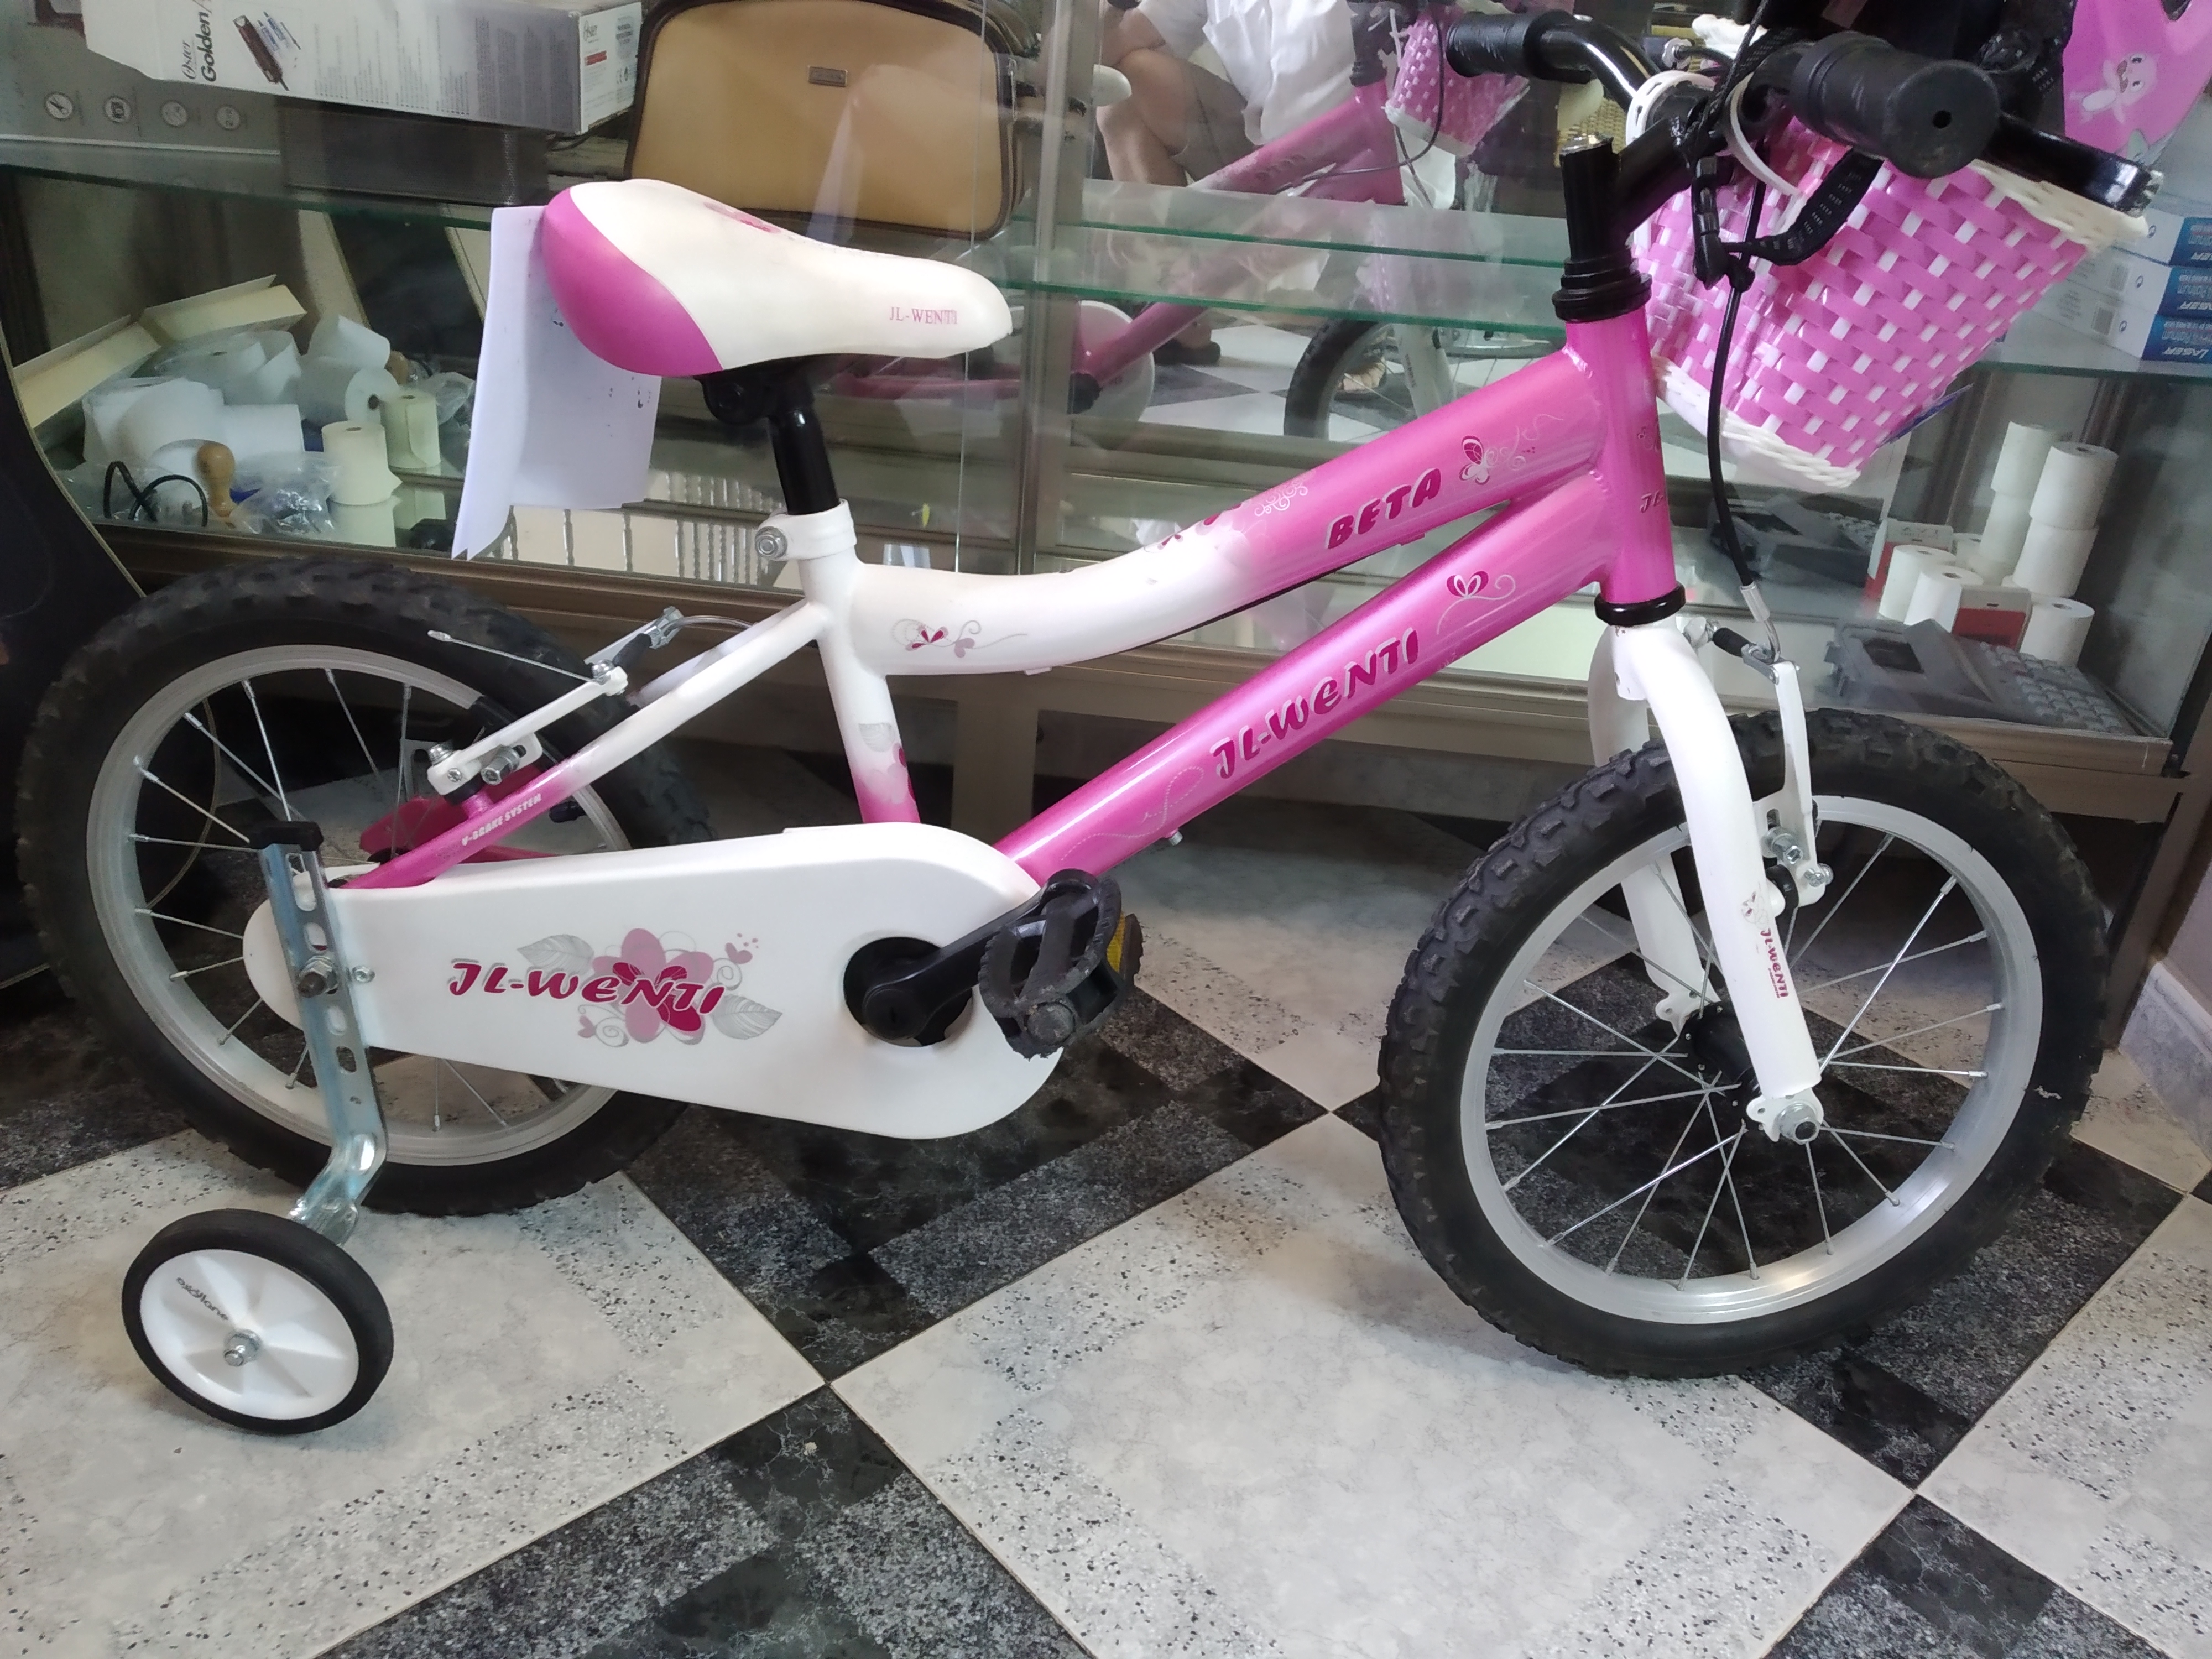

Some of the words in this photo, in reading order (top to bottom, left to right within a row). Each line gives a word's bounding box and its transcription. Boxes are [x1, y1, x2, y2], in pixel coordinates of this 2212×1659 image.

[195, 11, 216, 82] Golden
[889, 306, 958, 325] JL-WENTI
[2162, 347, 2209, 359] LASER
[1324, 467, 1442, 549] BETA
[461, 816, 503, 846] V-BRAKE
[504, 793, 542, 821] SYSTEM
